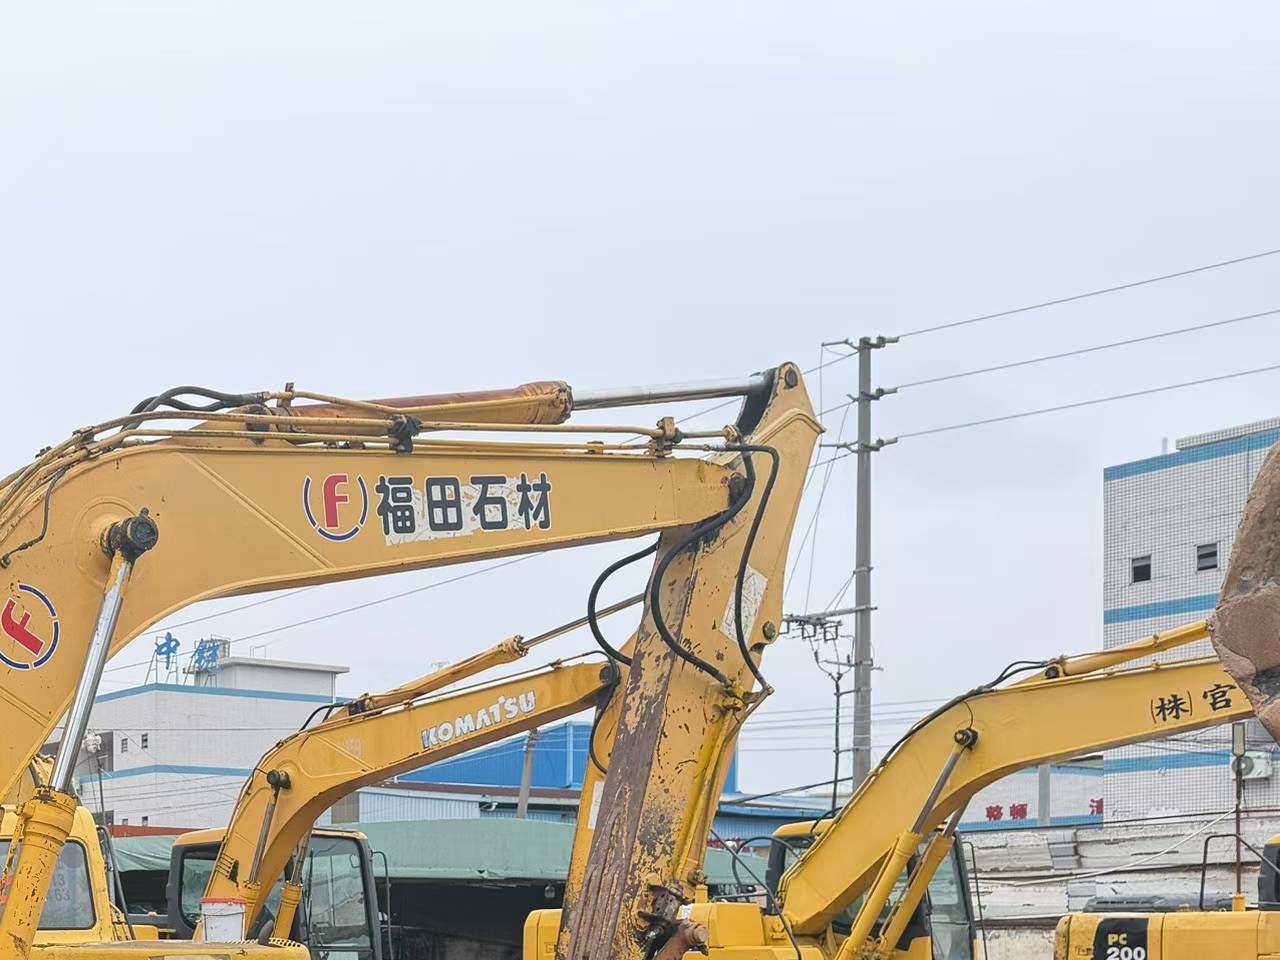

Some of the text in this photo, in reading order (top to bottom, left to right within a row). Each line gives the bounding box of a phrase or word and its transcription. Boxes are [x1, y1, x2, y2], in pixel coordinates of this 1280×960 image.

[375, 472, 551, 536] 福田石材
[421, 690, 536, 749] KOMATSU
[1108, 933, 1127, 946] PC
